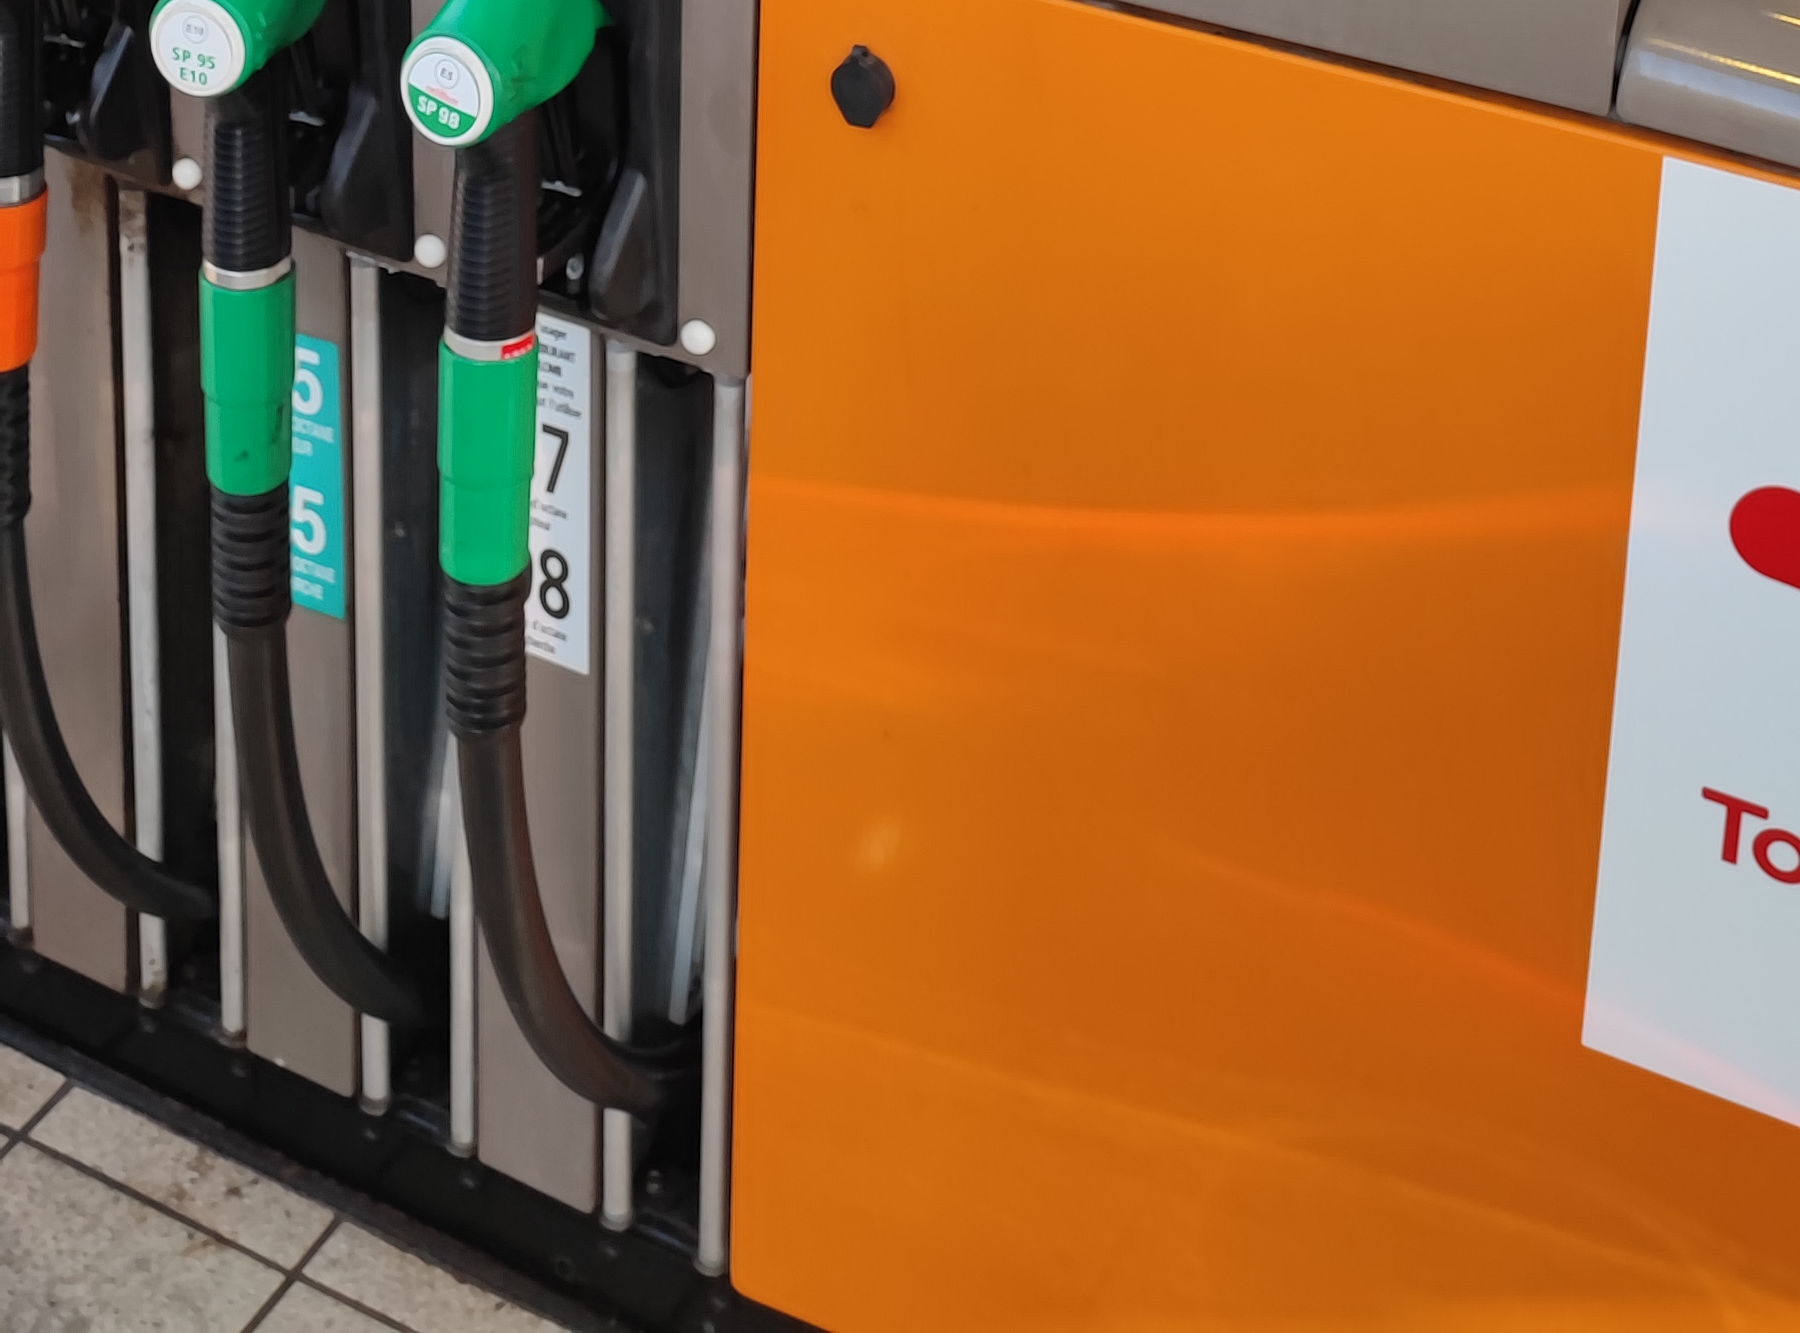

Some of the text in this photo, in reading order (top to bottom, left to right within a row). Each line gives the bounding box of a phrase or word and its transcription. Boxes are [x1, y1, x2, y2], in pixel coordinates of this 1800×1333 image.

[172, 47, 216, 69] SP 95
[180, 67, 208, 85] E10
[417, 95, 438, 116] SP
[438, 107, 460, 129] 98
[542, 424, 569, 493] 7
[291, 484, 327, 555] 5
[539, 549, 569, 619] 8
[1701, 786, 1800, 885] To
